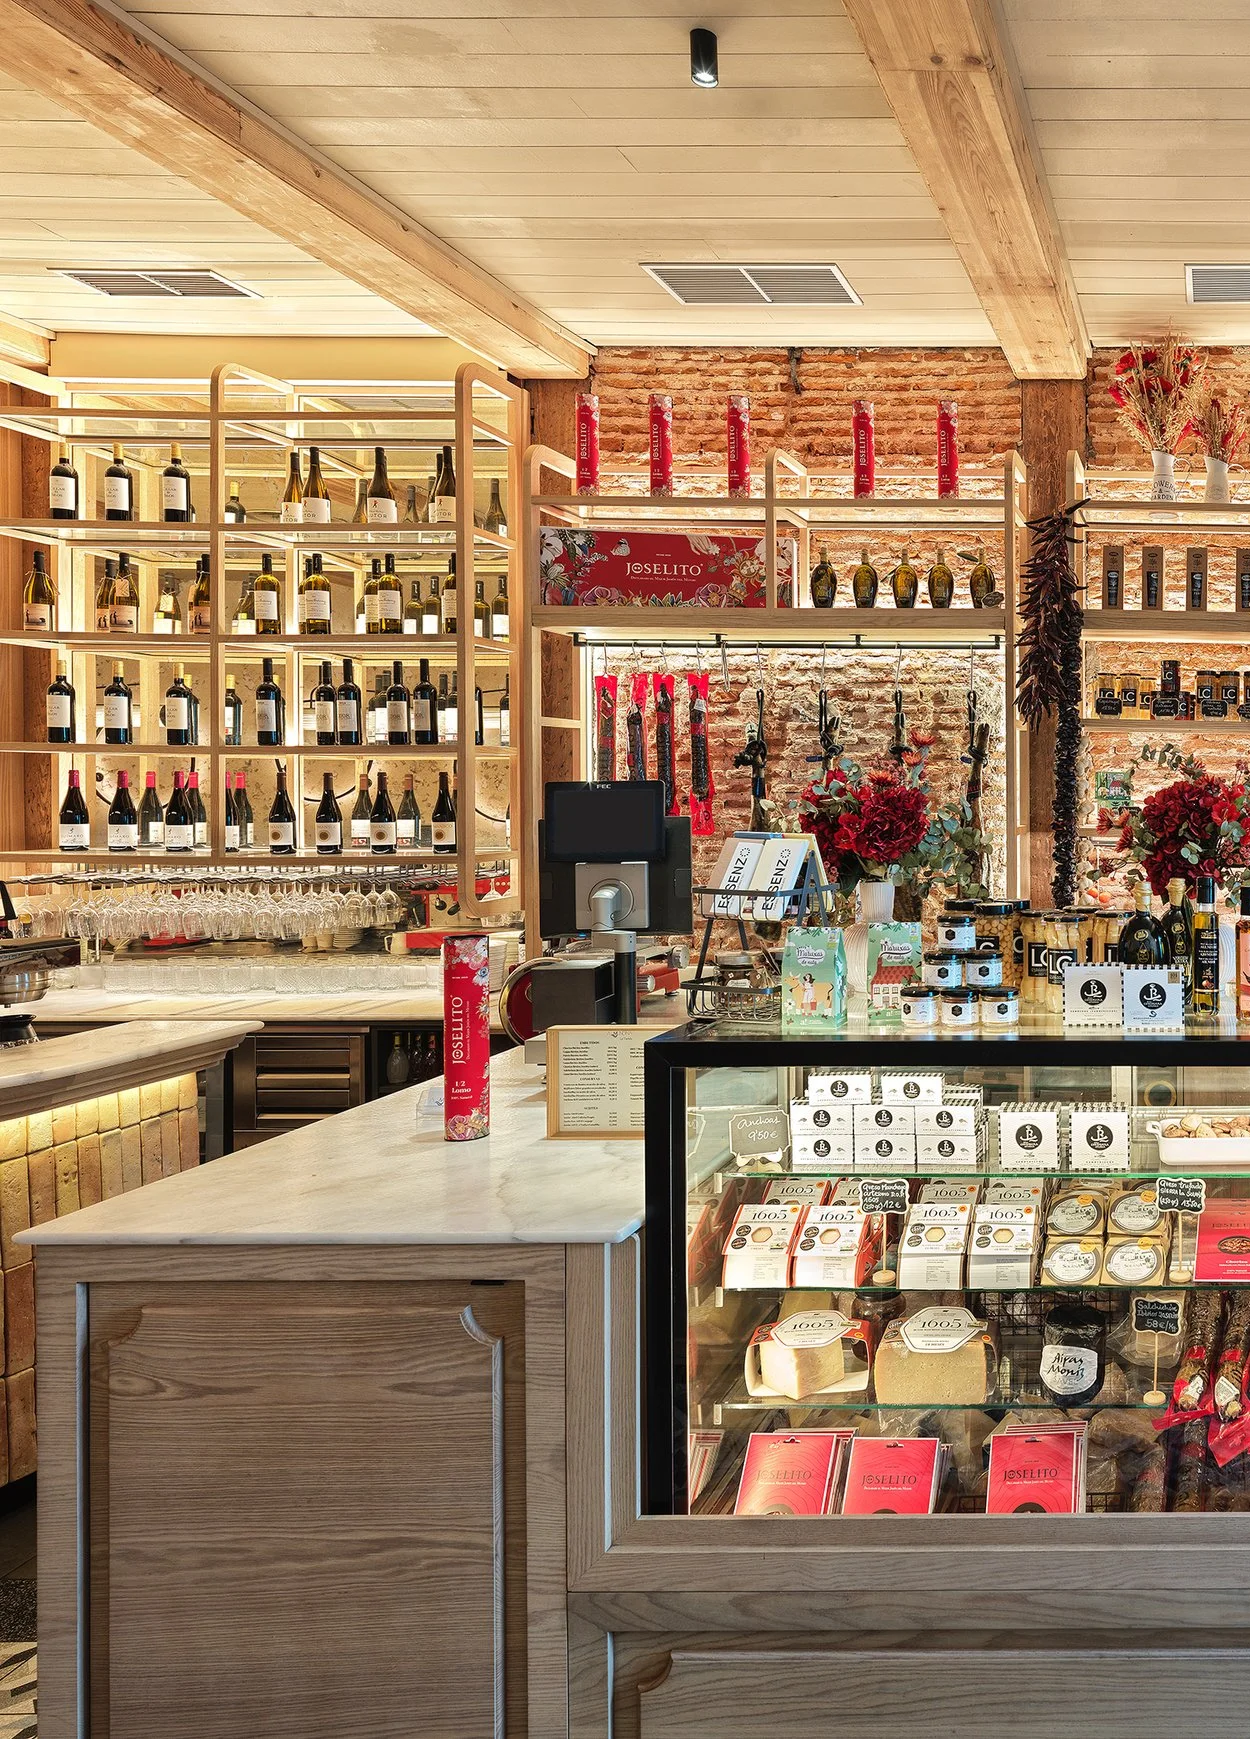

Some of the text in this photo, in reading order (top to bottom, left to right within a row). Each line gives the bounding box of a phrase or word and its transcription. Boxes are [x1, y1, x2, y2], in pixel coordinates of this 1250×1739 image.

[626, 562, 702, 576] JOSELITO
[452, 996, 466, 1064] JOSELITO
[780, 1186, 815, 1194] 1605
[933, 1187, 967, 1197] 1605
[998, 1190, 1032, 1199] 1605
[752, 1210, 788, 1221] 1605
[820, 1211, 855, 1222] 1605
[924, 1206, 959, 1218] 1605
[989, 1208, 1024, 1220] 1605
[792, 1320, 834, 1330] 1605
[920, 1318, 962, 1328] 1605
[756, 1470, 812, 1481] JOSELITO
[862, 1474, 917, 1486] JOSELITO
[1003, 1468, 1058, 1481] JOSELITO
